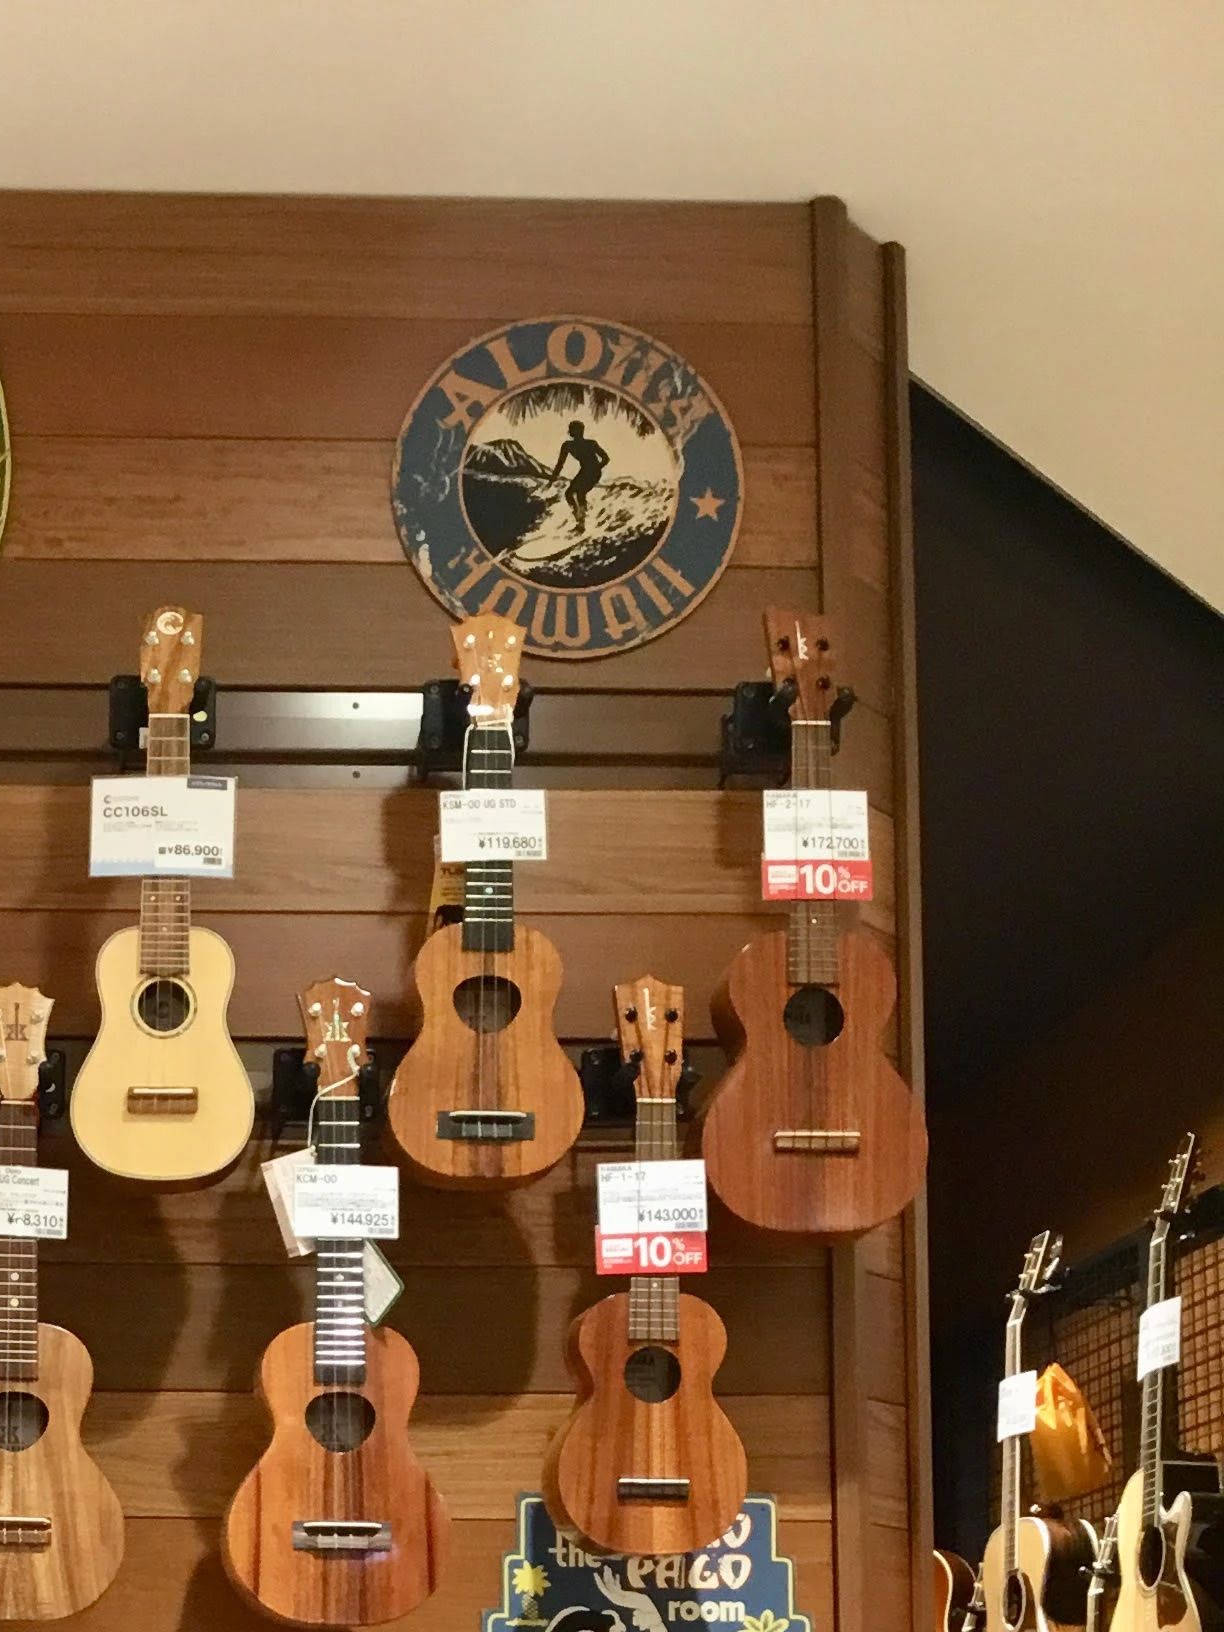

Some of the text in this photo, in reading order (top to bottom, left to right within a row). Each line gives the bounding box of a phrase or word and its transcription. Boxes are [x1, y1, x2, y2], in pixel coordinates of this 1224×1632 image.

[103, 806, 168, 818] CC106SL
[479, 837, 536, 848] ¥119,680
[802, 837, 859, 848] ¥172,700
[168, 845, 219, 856] ¥86,900
[838, 880, 868, 893] OFF
[331, 1212, 389, 1226] ¥144,925
[639, 1208, 697, 1222] ¥143,000
[673, 1252, 702, 1265] OFF
[549, 1531, 603, 1568] the
[627, 1555, 752, 1590] PAGO
[668, 1599, 746, 1623] room
